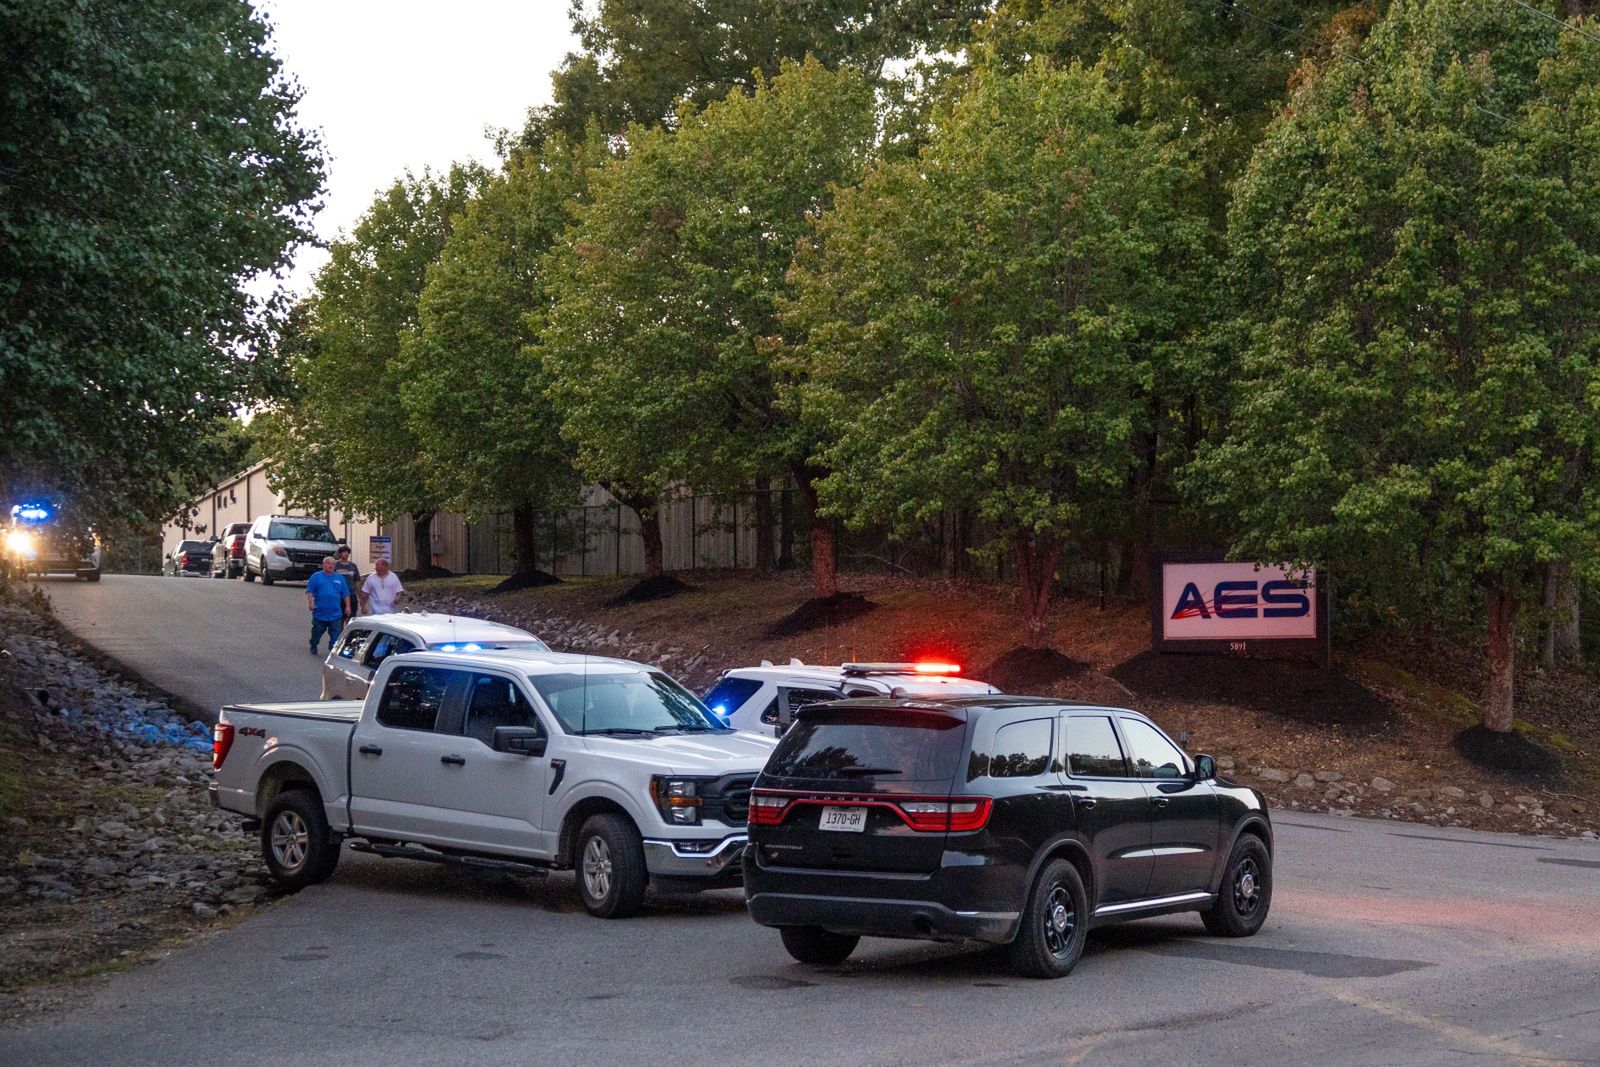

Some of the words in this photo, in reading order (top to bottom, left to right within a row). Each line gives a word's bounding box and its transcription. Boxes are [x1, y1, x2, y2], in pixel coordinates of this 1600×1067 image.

[1171, 580, 1310, 619] AES
[1230, 642, 1247, 651] 5891
[825, 812, 862, 825] 1370-GH
